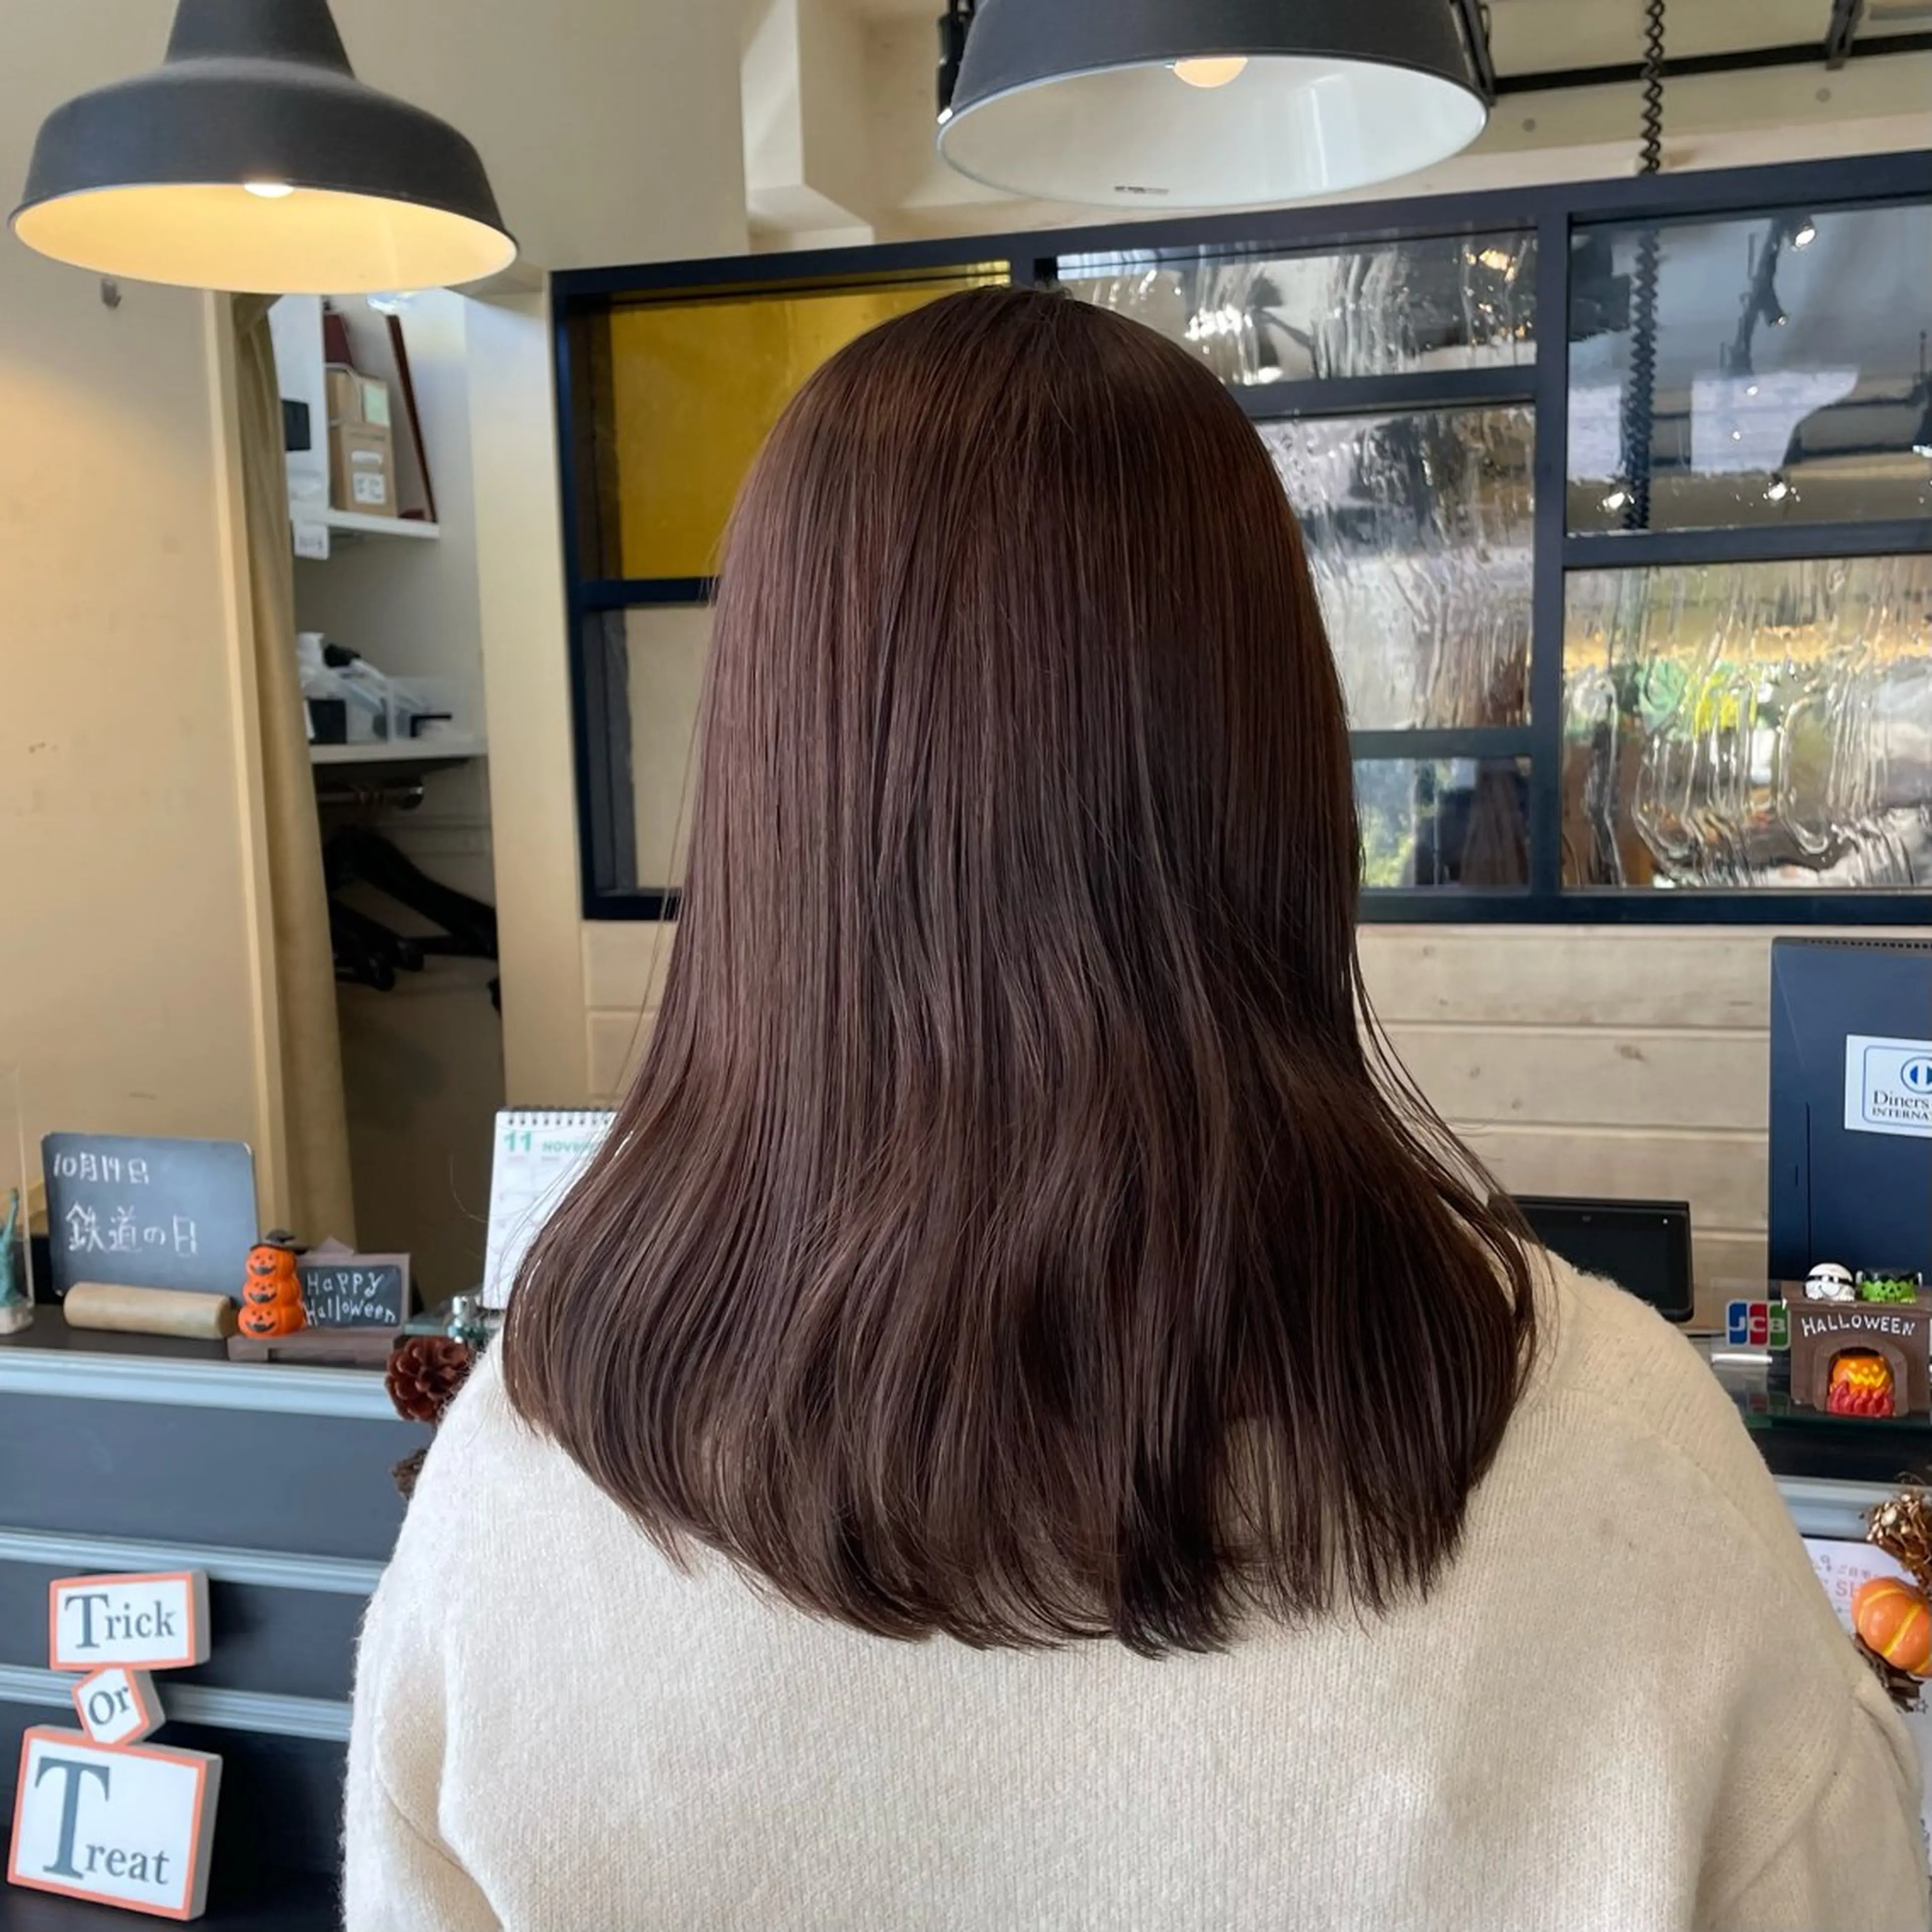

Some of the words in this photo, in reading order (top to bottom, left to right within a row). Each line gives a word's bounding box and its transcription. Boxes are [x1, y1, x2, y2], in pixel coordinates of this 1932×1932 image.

[1872, 1106, 1932, 1121] INTERNA
[1873, 1090, 1929, 1109] Diners
[504, 1129, 533, 1153] 11
[65, 1201, 198, 1258] 鉄道の日
[1801, 1313, 1915, 1338] HALLOWEEN
[64, 1593, 177, 1649] Trick
[88, 1685, 130, 1726] Or
[34, 1756, 171, 1885] Treat
